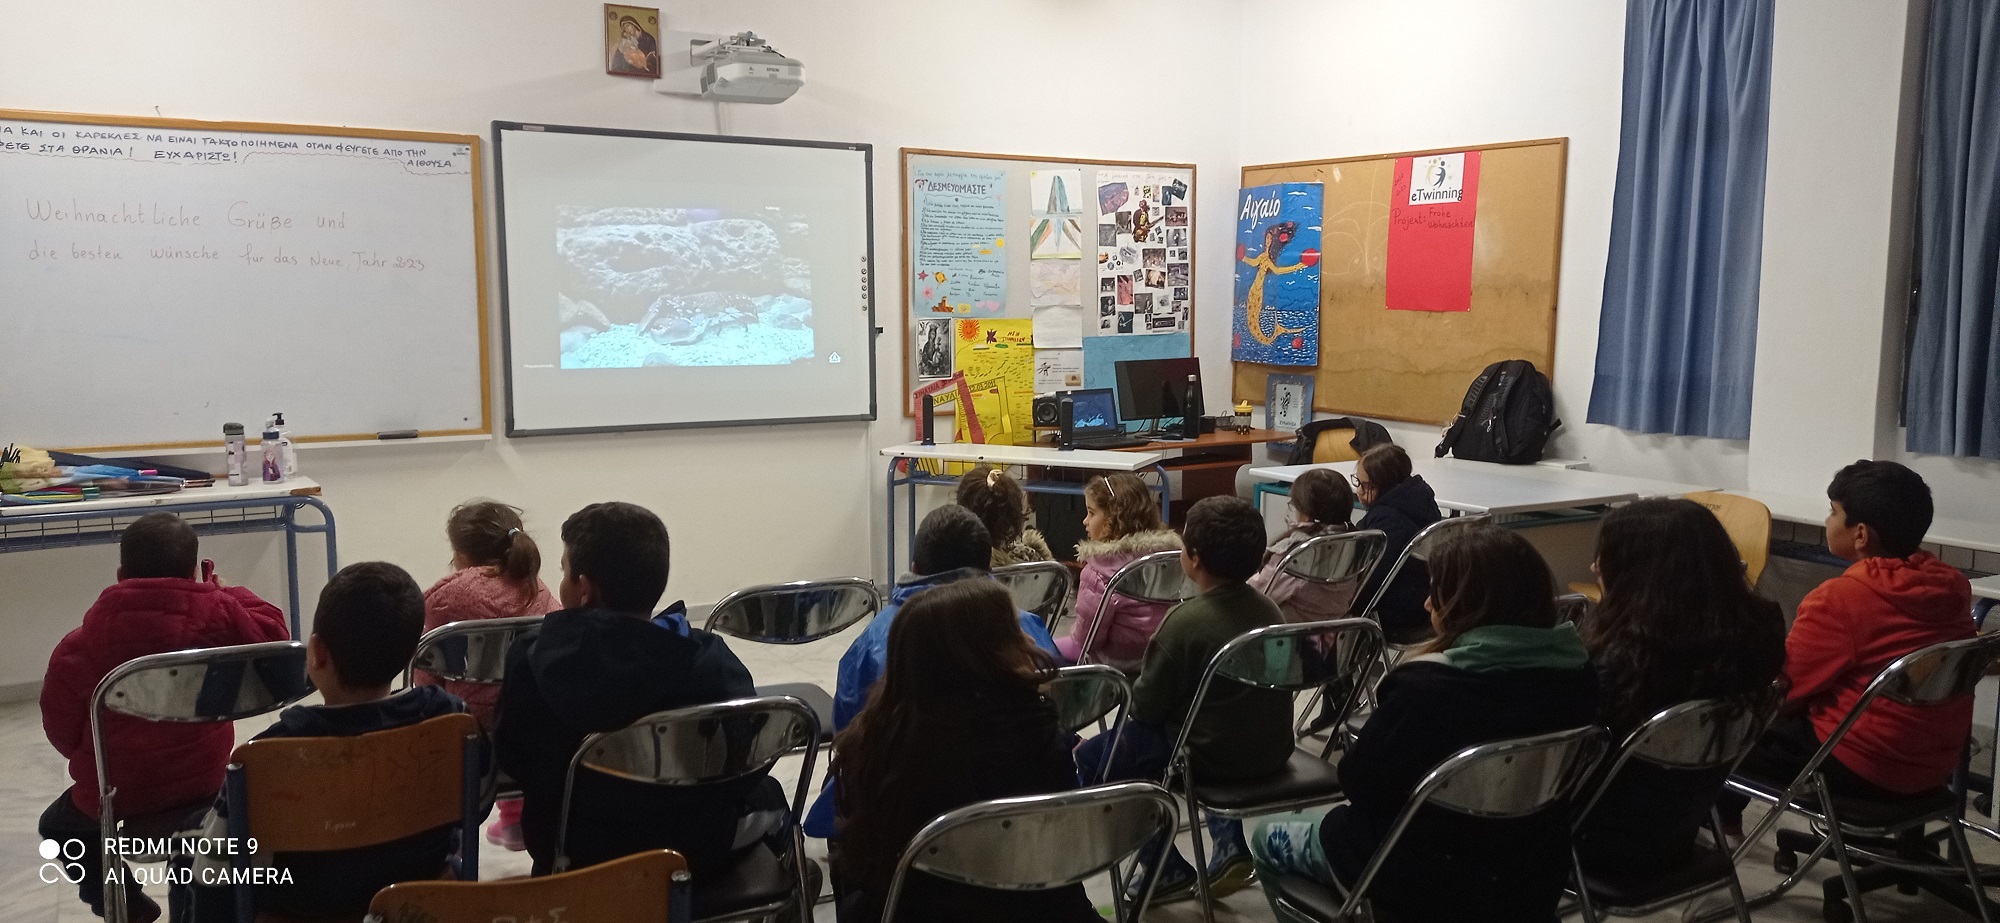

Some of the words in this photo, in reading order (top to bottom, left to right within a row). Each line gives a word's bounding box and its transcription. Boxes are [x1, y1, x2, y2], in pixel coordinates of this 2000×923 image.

[21, 126, 43, 137] ΚΑΙ
[146, 134, 163, 143] ΝΑ
[168, 136, 197, 145] ΕΙΝΑΙ
[306, 142, 332, 151] ΟΤΑΝ
[407, 149, 427, 157] ΤΗΝ
[39, 143, 65, 153] ΣΤΑ
[406, 159, 452, 168] ΑΙΘΟΥΣΑ
[1411, 187, 1463, 202] eTwinning
[1240, 190, 1280, 230] Αιγαίο
[316, 211, 345, 229] und
[29, 239, 58, 261] die
[71, 242, 123, 260] besten
[273, 246, 298, 265] das
